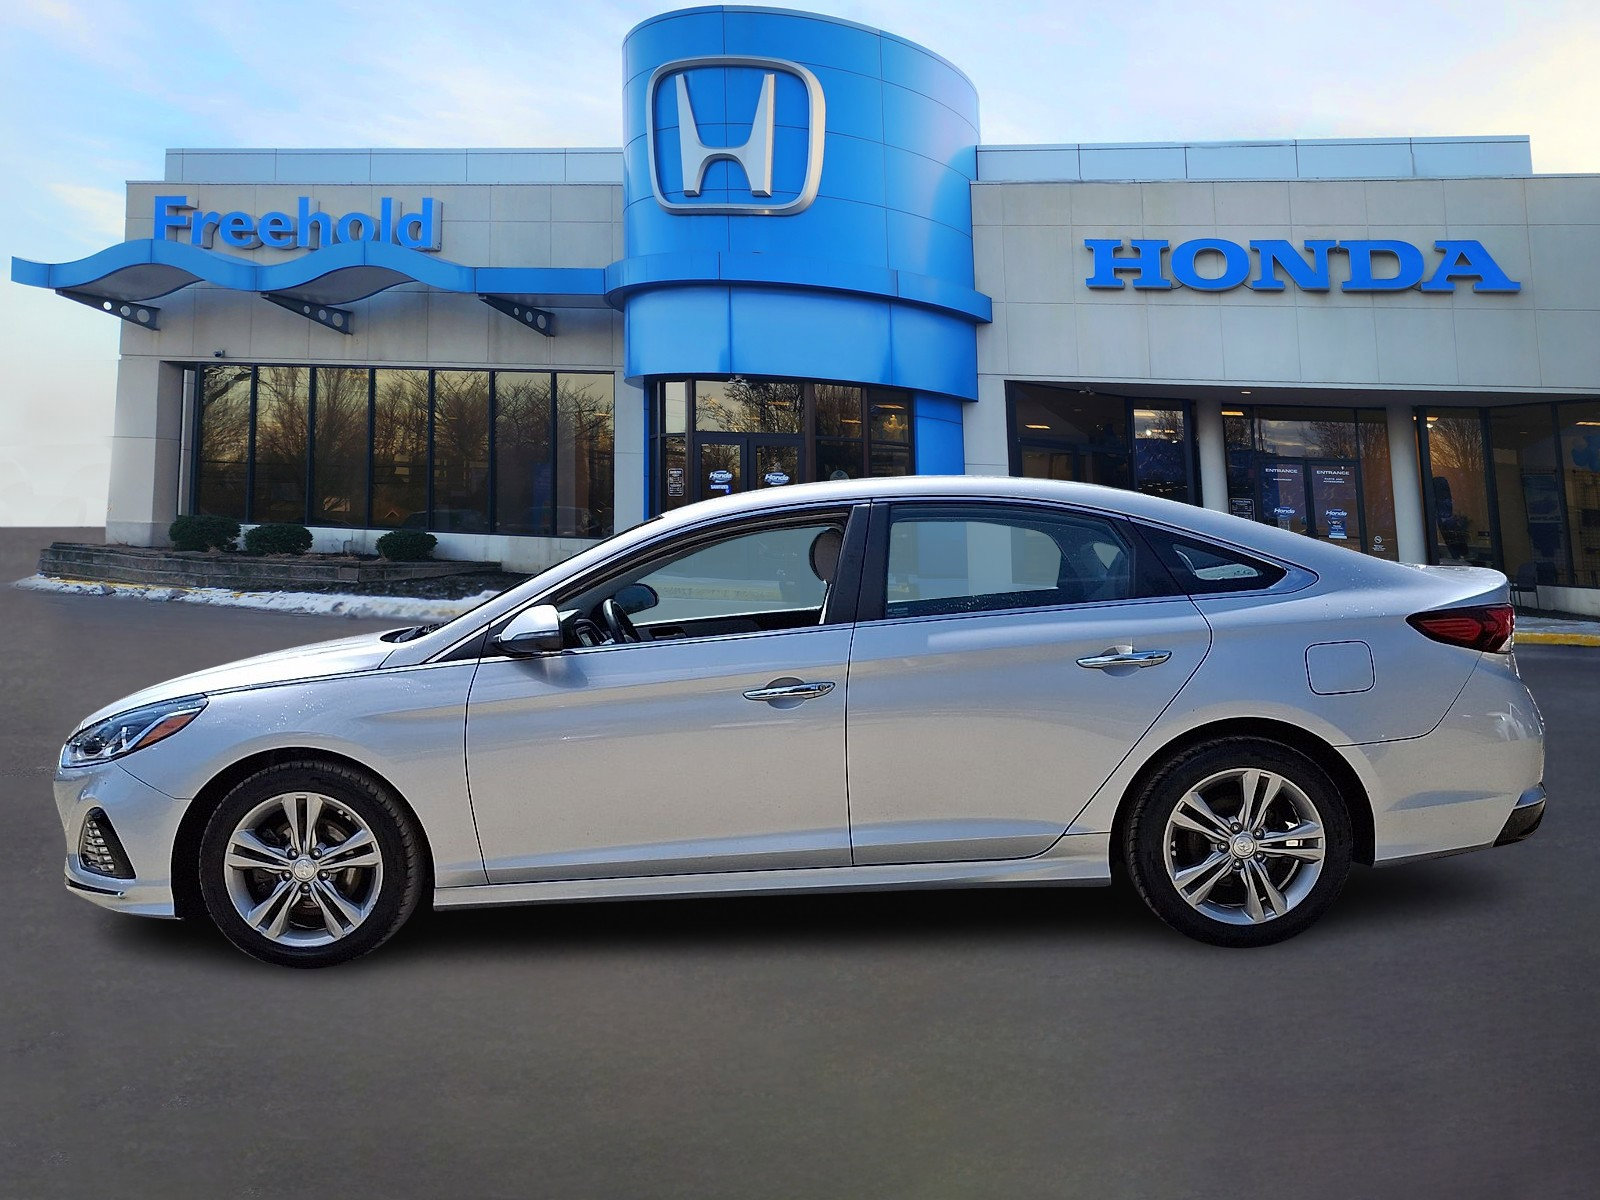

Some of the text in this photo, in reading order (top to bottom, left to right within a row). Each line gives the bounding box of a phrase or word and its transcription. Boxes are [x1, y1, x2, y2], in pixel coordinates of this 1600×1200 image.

[154, 196, 437, 248] Freehold
[1084, 238, 1521, 291] HONDA
[709, 471, 733, 481] Honda
[765, 473, 790, 482] Honda
[1325, 509, 1348, 517] Honda
